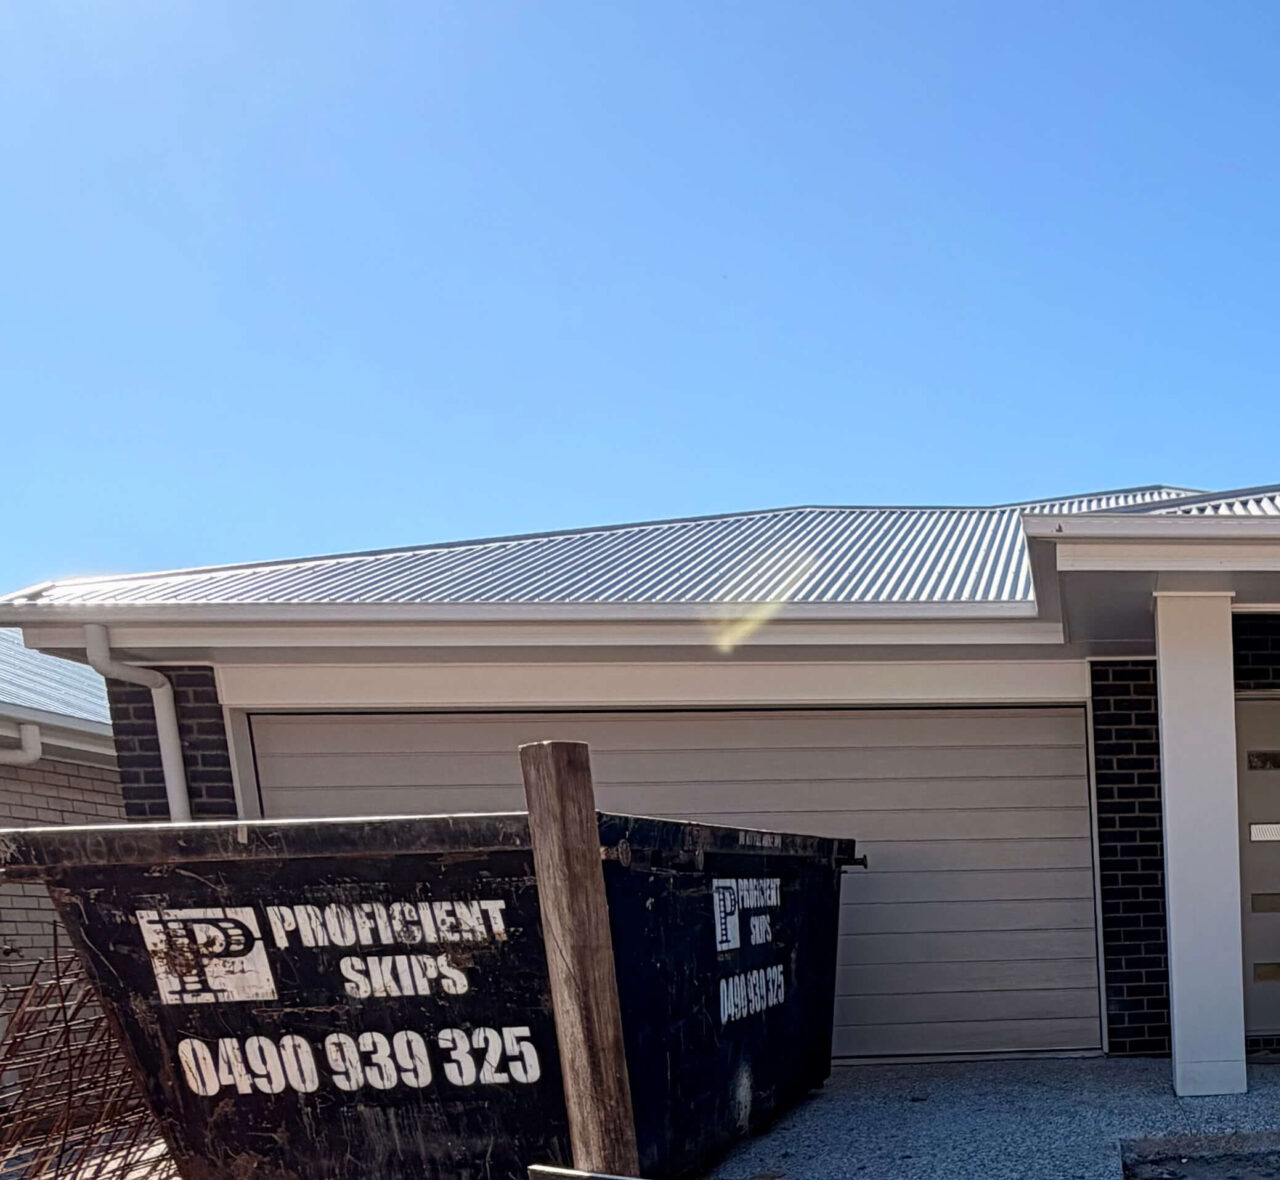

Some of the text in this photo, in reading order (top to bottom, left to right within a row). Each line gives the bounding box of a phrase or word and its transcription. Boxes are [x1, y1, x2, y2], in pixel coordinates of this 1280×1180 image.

[738, 877, 781, 910] PROFICIENT
[266, 899, 506, 950] PROFICIENT
[750, 913, 772, 946] SKIPS
[339, 952, 469, 1000] SKIPS
[719, 963, 785, 1025] 0490 939 325
[178, 1025, 543, 1097] 0490 939 325
